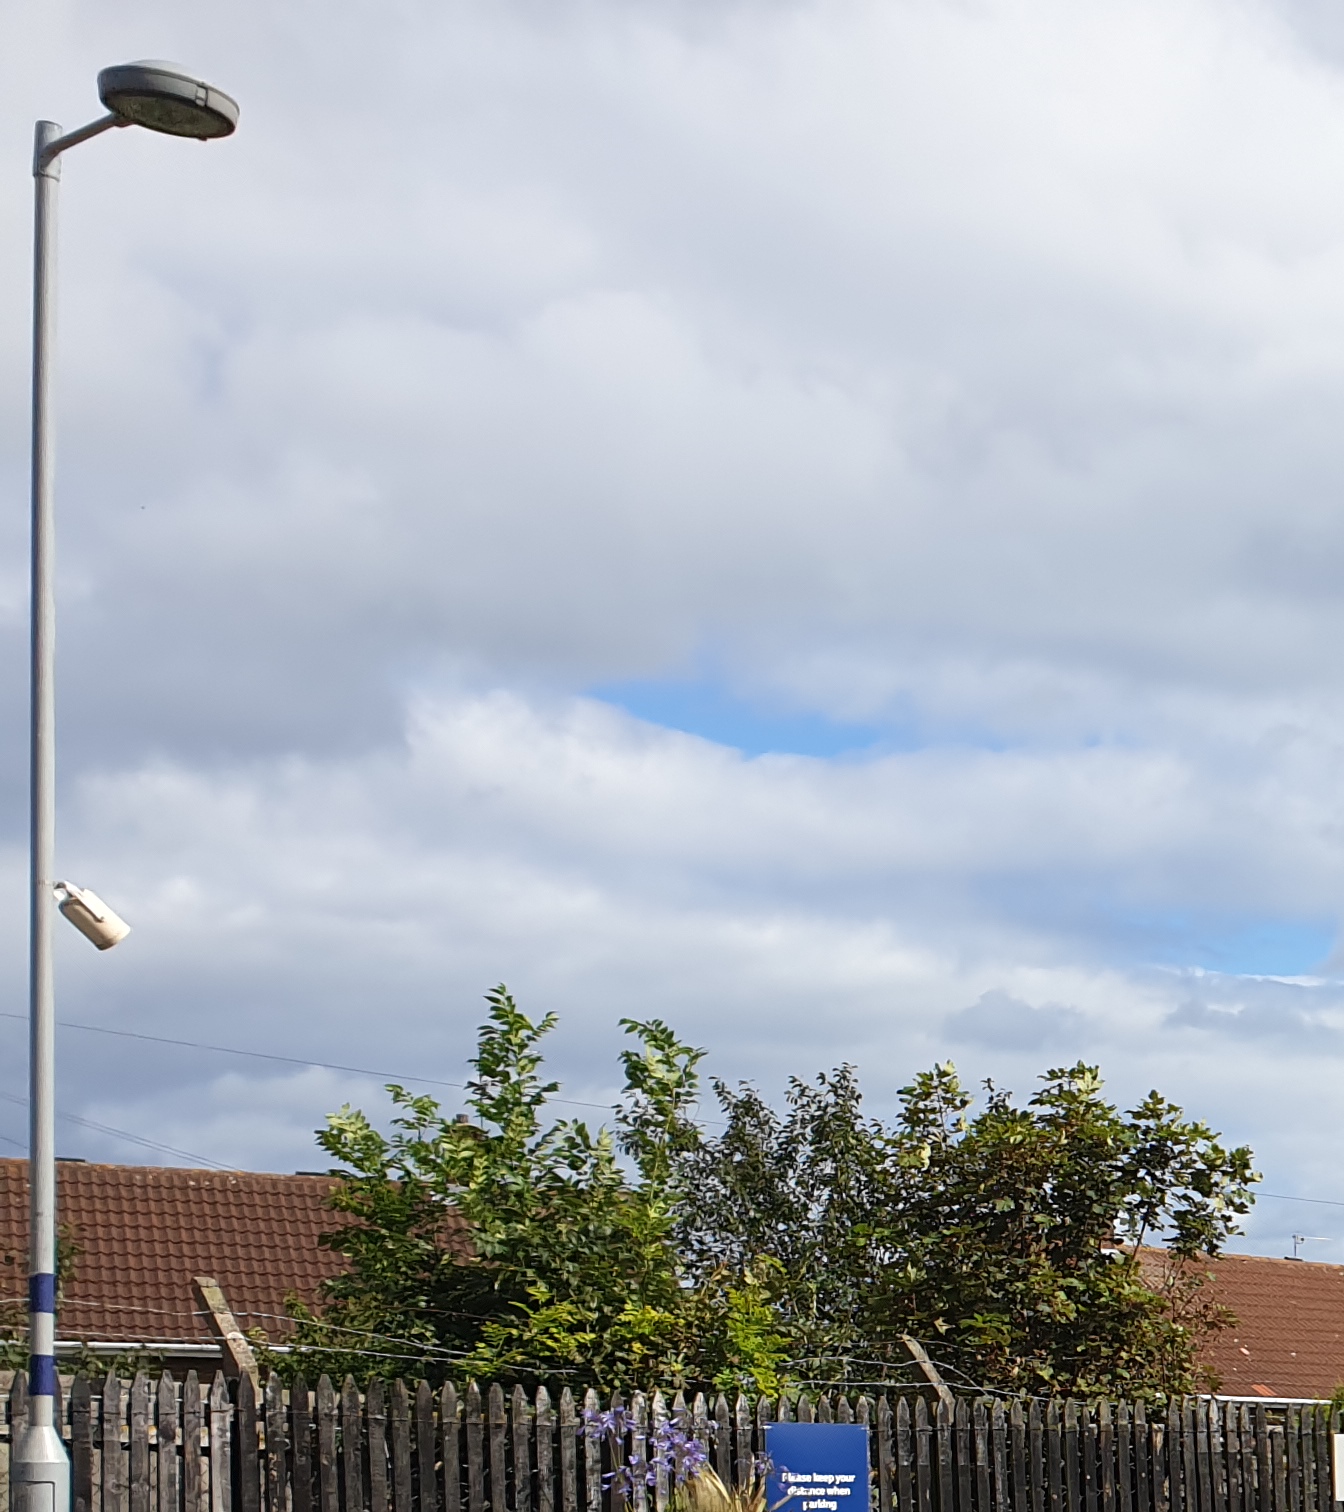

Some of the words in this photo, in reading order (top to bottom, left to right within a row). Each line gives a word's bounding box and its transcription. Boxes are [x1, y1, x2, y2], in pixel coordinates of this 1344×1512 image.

[782, 1472, 812, 1482] Please
[812, 1472, 835, 1485] keep
[835, 1474, 856, 1485] your
[826, 1486, 851, 1496] when
[802, 1498, 837, 1511] parking
